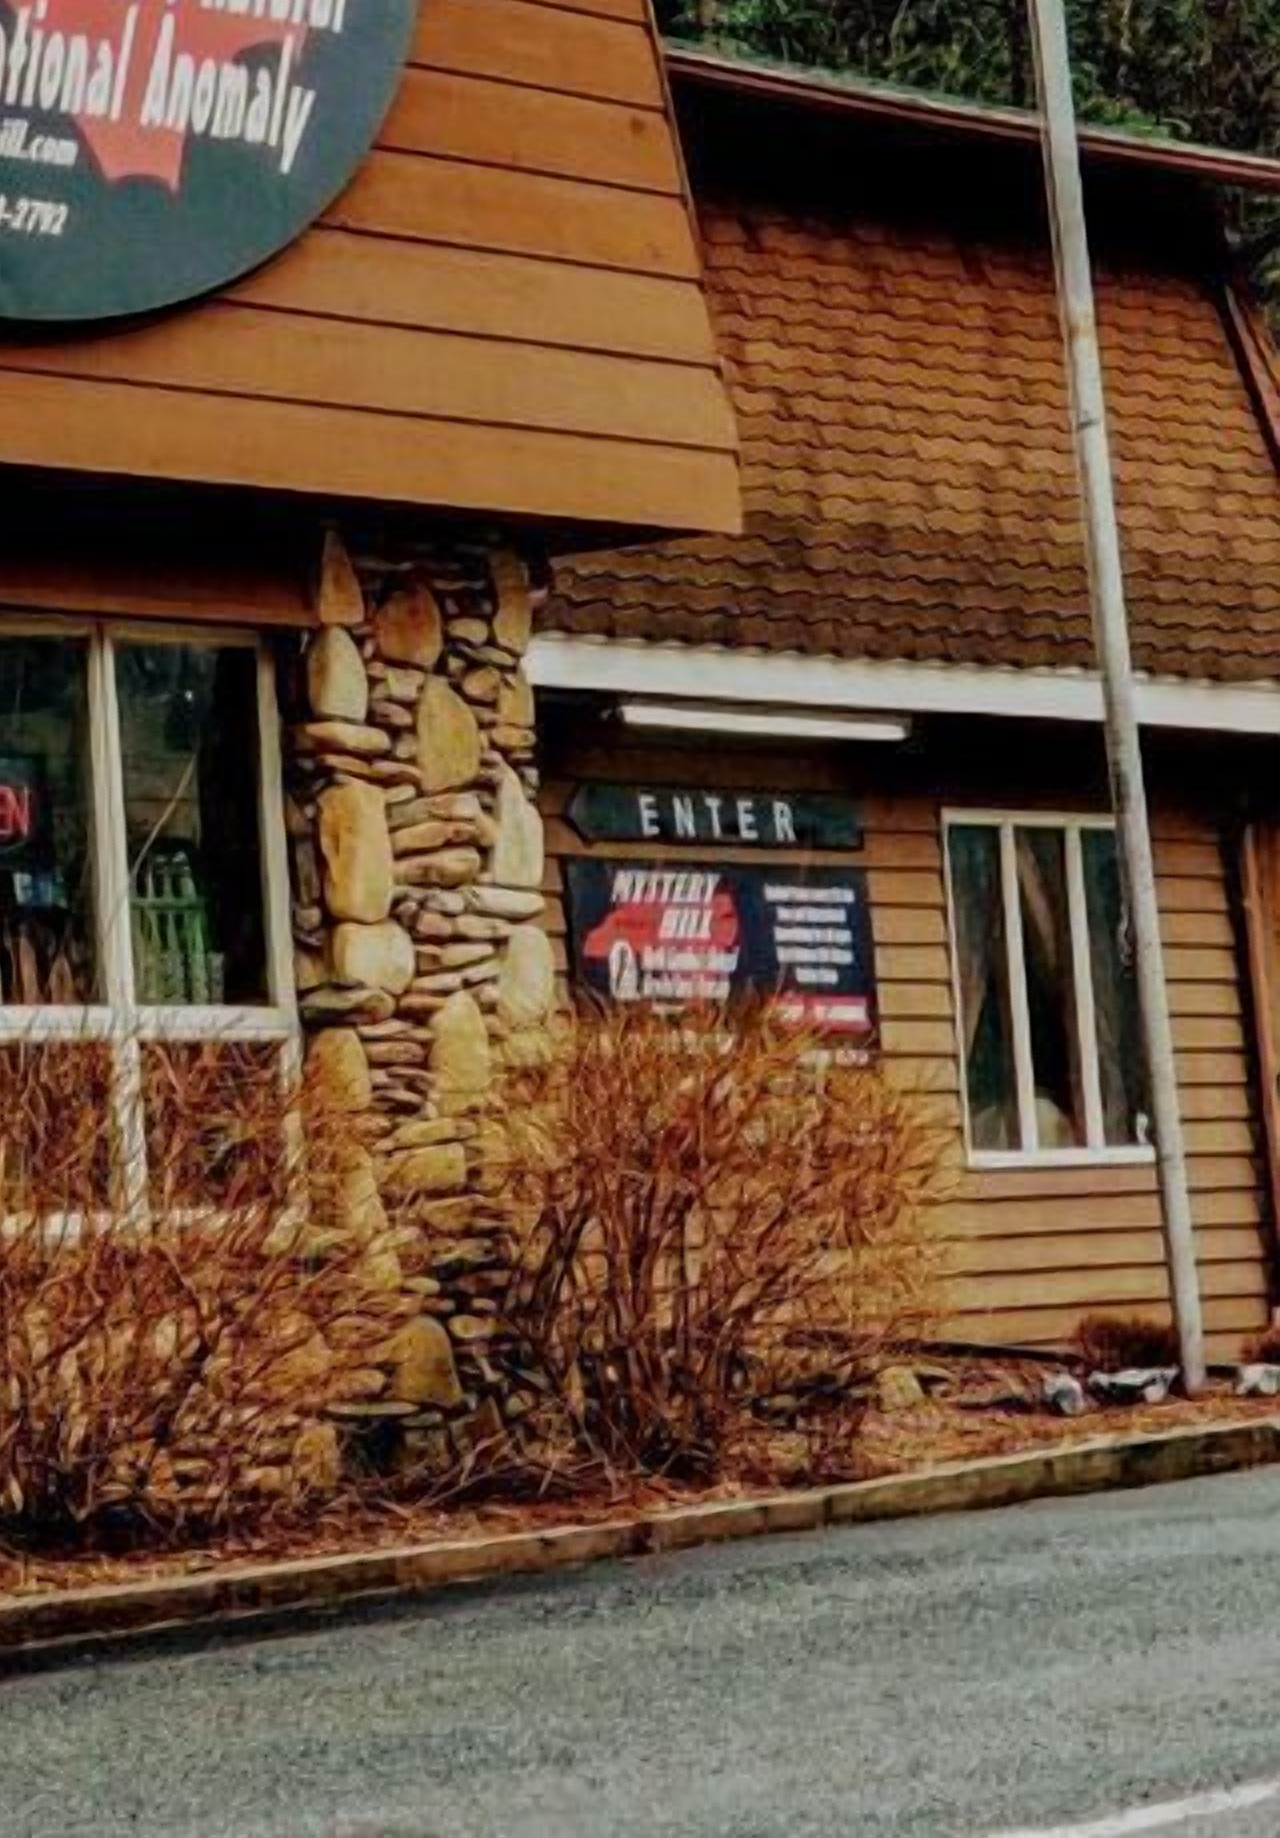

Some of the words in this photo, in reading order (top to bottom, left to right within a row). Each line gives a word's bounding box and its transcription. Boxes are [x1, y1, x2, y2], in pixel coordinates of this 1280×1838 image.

[139, 12, 317, 175] Anomaly
[638, 793, 797, 842] ENTER
[610, 869, 721, 904] MYSTERY
